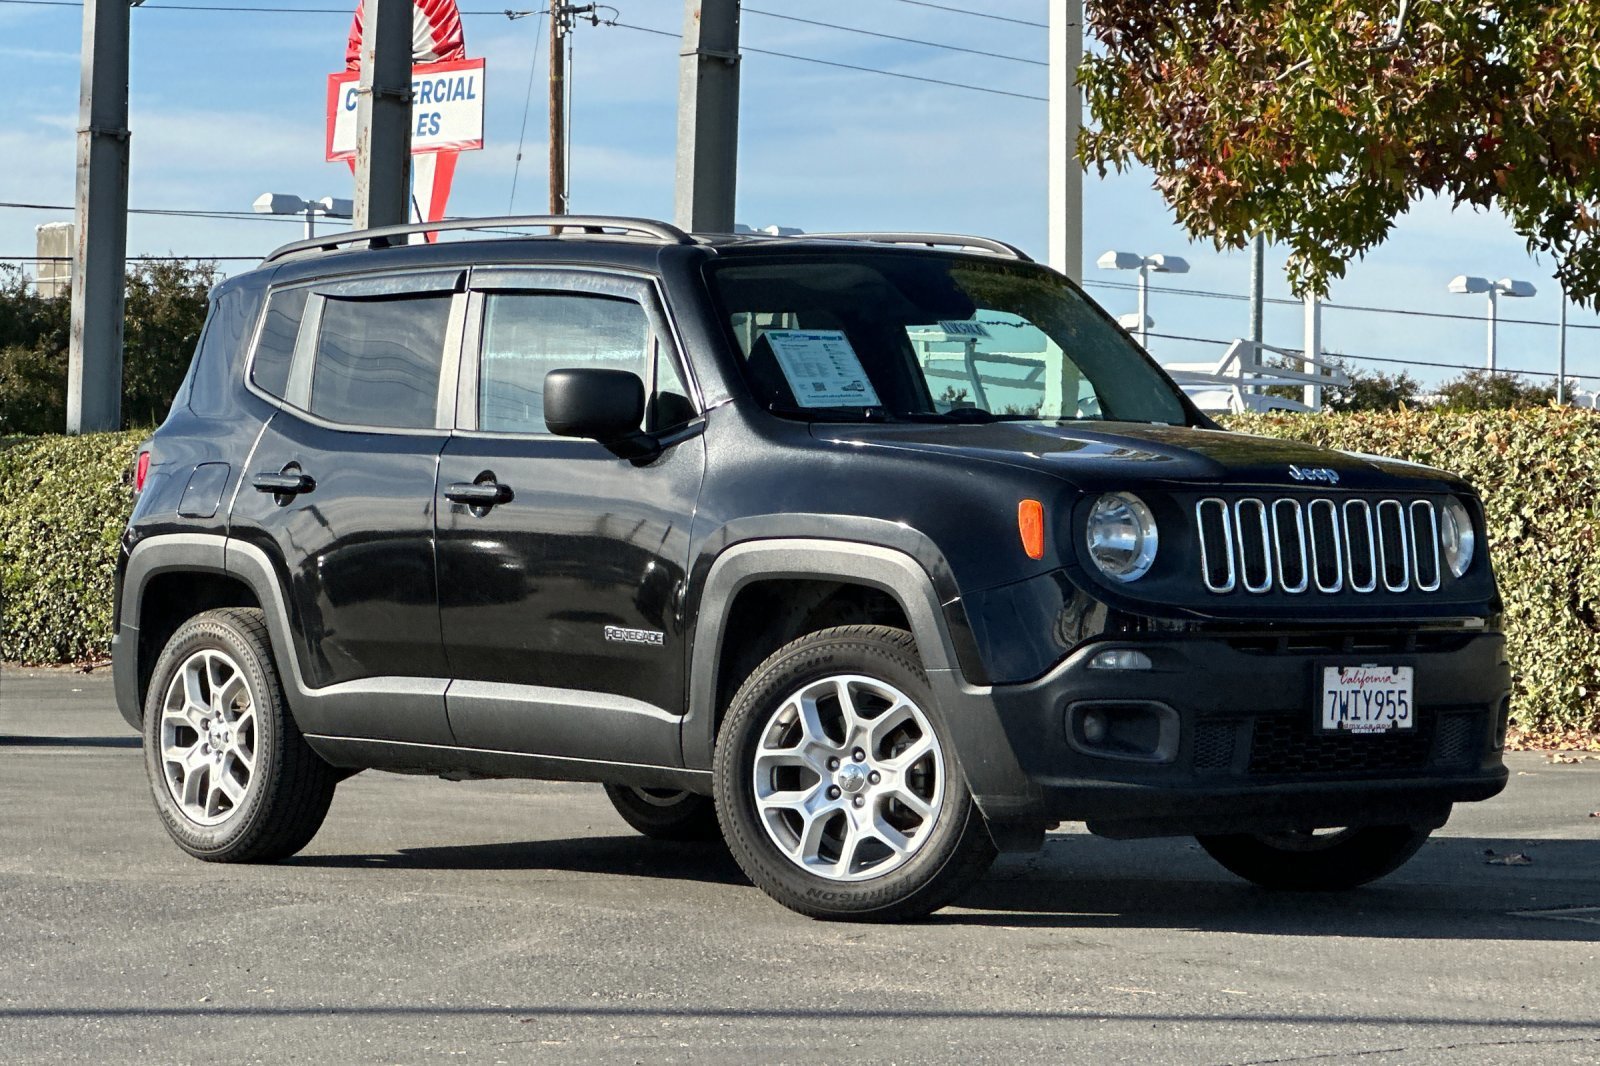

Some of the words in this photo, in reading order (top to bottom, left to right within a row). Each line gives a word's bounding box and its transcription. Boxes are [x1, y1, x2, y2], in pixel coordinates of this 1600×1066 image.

[345, 75, 476, 112] CERCIAL
[1289, 464, 1340, 484] Jeep
[604, 625, 664, 645] RENEGADE
[1340, 669, 1397, 689] California
[1327, 689, 1408, 720] 7WIY955
